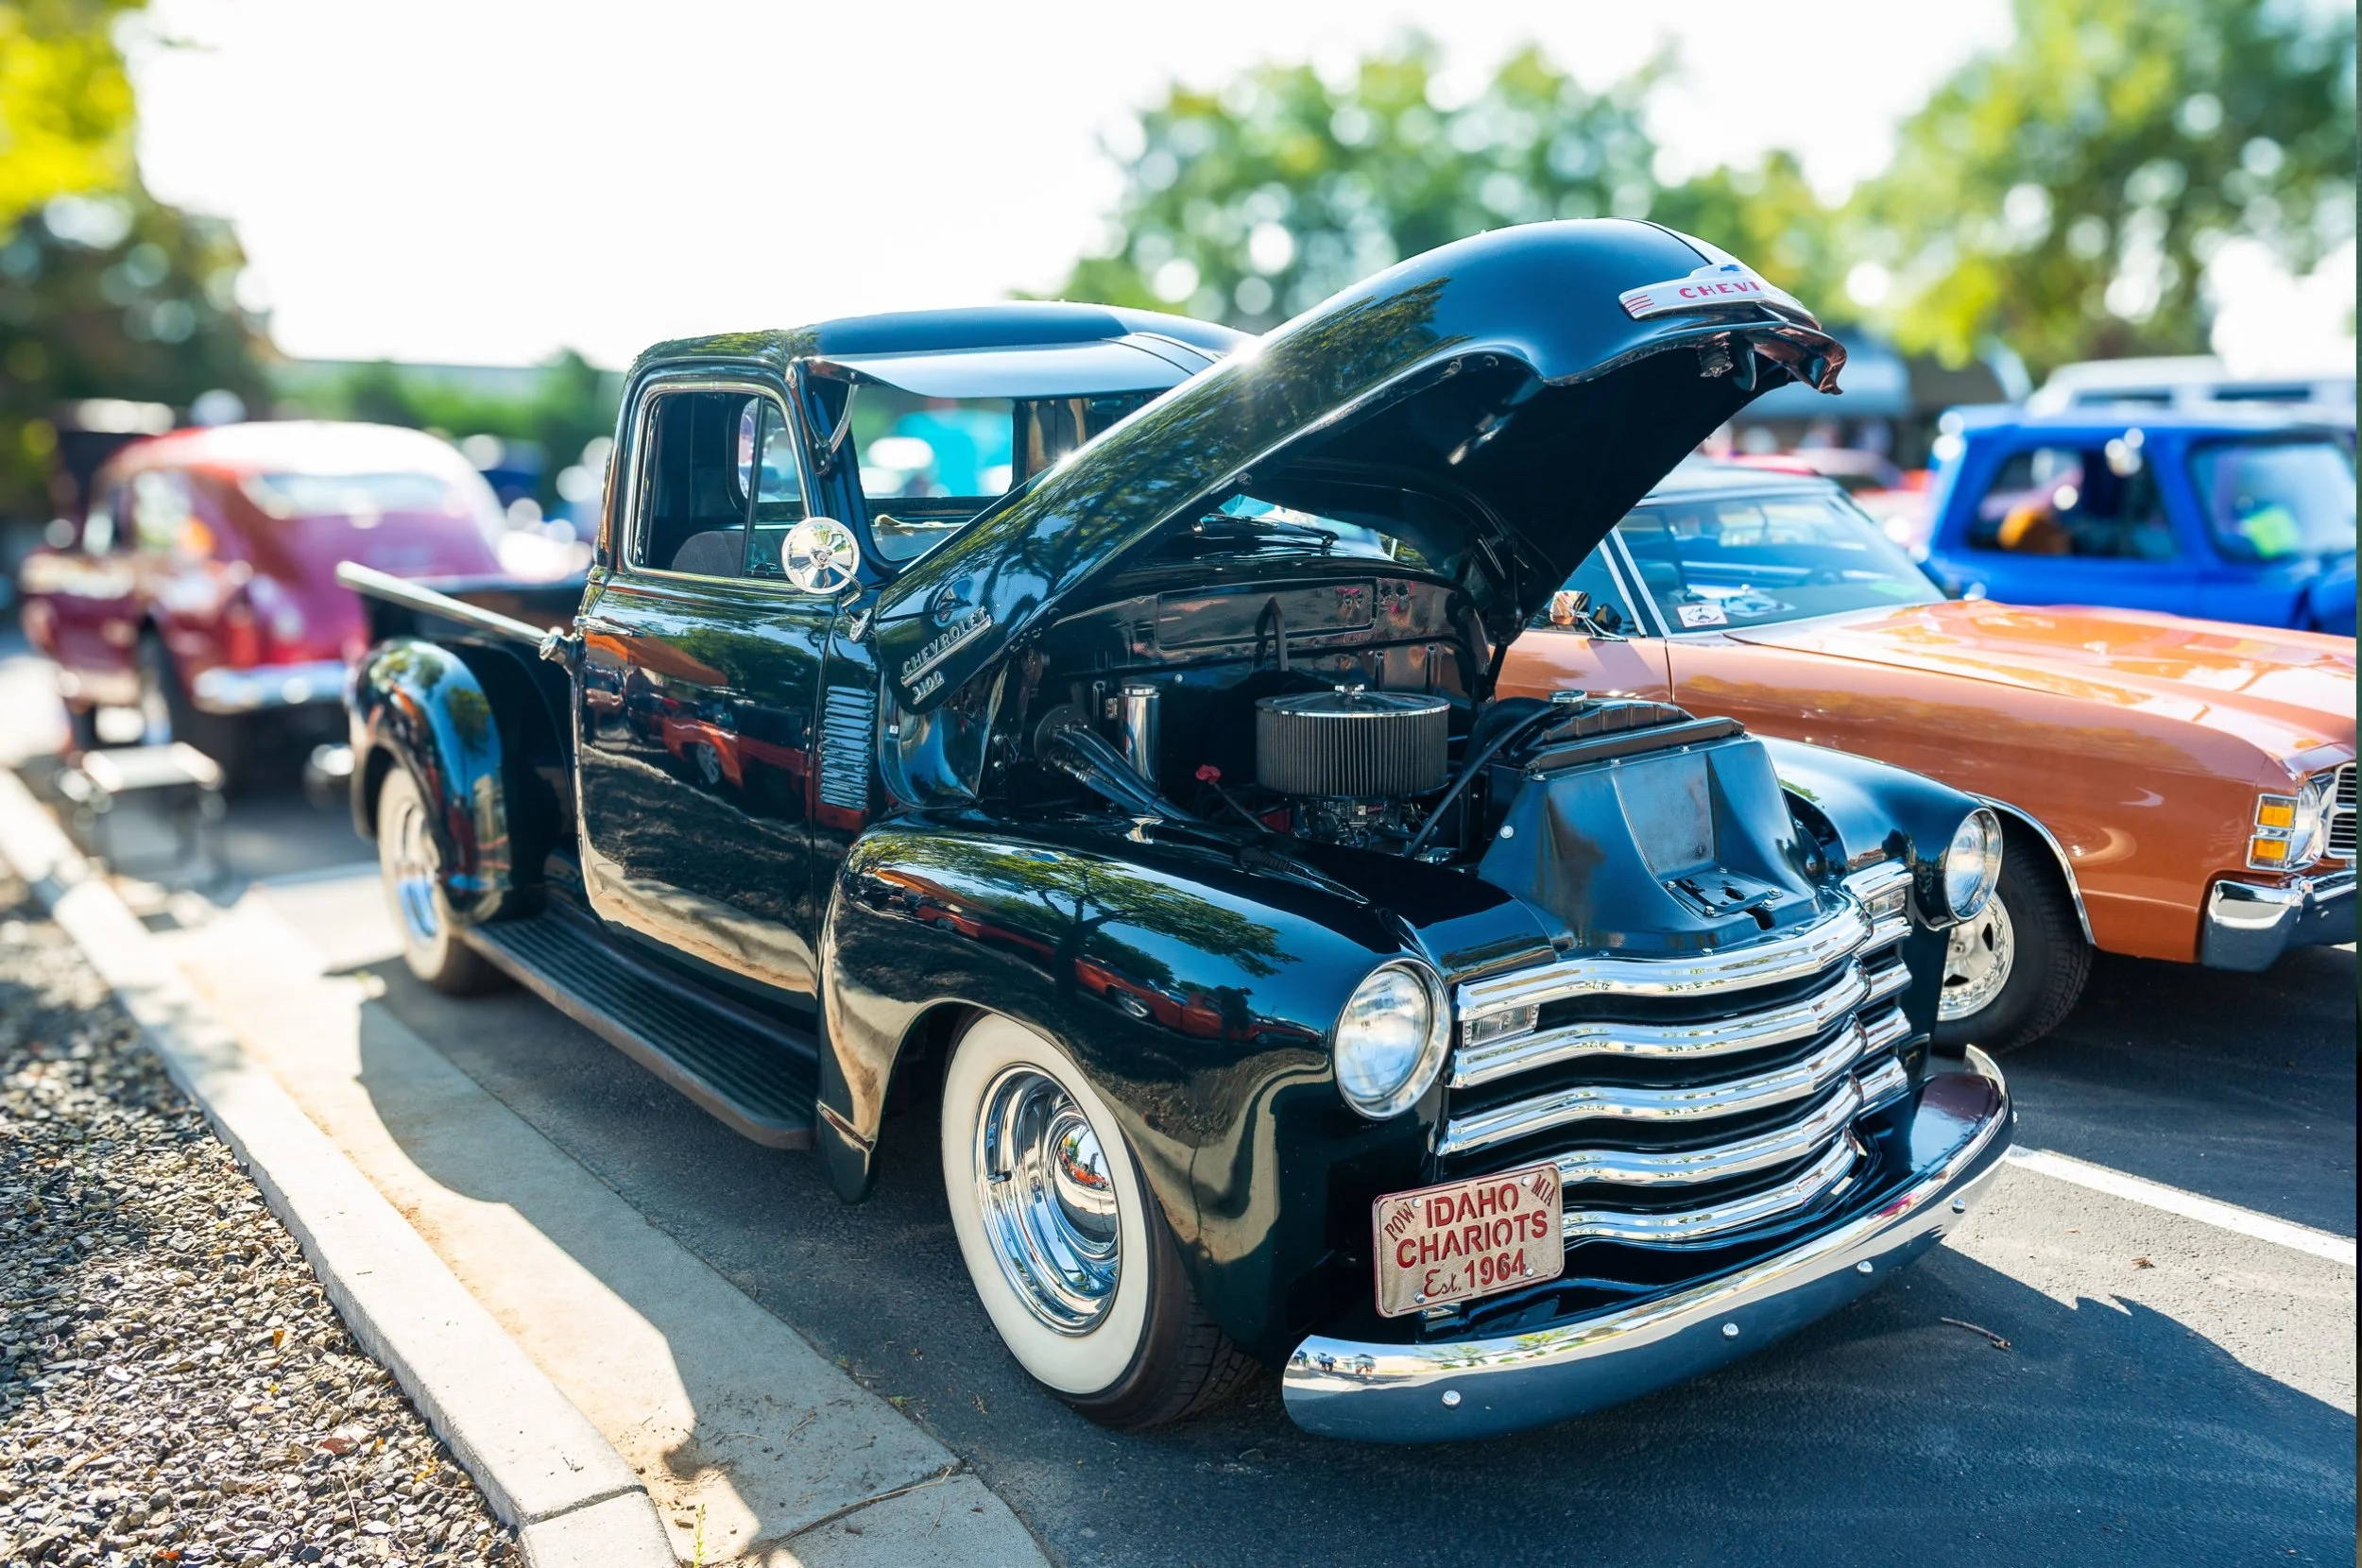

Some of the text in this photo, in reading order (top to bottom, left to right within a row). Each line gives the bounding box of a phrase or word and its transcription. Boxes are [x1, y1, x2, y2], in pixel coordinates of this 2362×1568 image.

[902, 605, 988, 675] CHEVROLET
[912, 670, 943, 700] 3100
[1426, 1183, 1519, 1229] IDAHO
[1531, 1174, 1556, 1207] MIA
[1384, 1202, 1415, 1242] POW
[1395, 1209, 1549, 1269] CHARIOTS
[1423, 1248, 1527, 1298] Est. 1964
